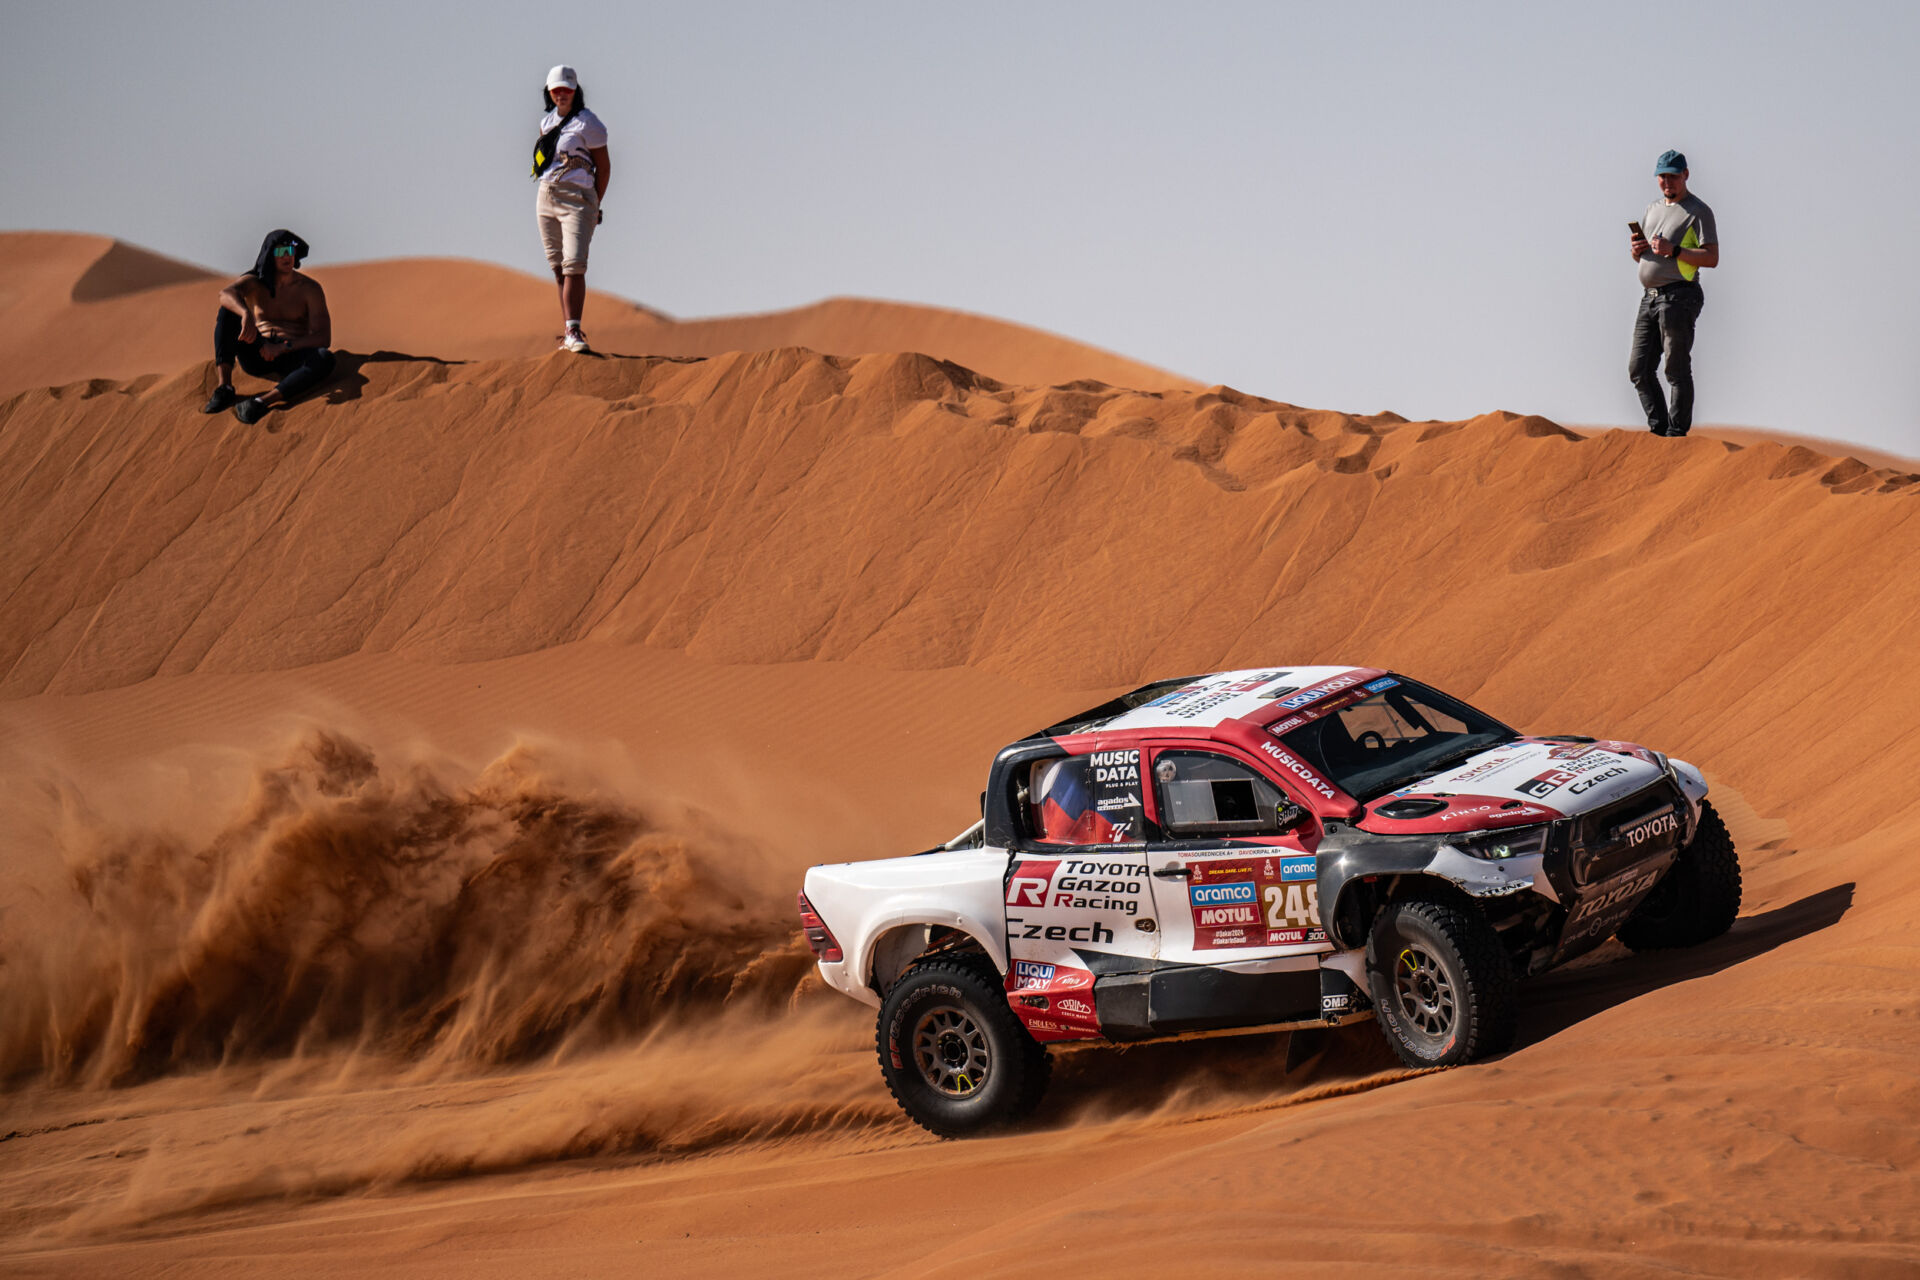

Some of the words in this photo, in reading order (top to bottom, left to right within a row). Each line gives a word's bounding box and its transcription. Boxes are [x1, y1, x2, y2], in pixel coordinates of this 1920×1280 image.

[1281, 689, 1327, 708] LIQUI
[1319, 676, 1357, 692] MOLY
[1367, 680, 1394, 691] aramco
[1272, 717, 1302, 734] MOTUL
[1090, 750, 1140, 767] MUSIC
[1556, 752, 1606, 769] TOYOTA
[1566, 757, 1611, 771] GAZOO
[1575, 759, 1622, 774] Racing
[1096, 766, 1139, 782] DATA
[1260, 741, 1335, 799] MUSICDATA
[1449, 757, 1510, 782] TOYOTA
[1528, 772, 1577, 798] GR
[1568, 767, 1628, 795] Czech
[1097, 796, 1129, 806] agados
[1440, 805, 1491, 821] KINTO
[1626, 813, 1678, 847] TOYOTA
[1067, 861, 1149, 877] TOYOTA
[1283, 863, 1317, 874] aramc
[1057, 877, 1141, 894] GAZOO
[1195, 886, 1251, 902] aramco
[1053, 894, 1138, 915] Racing
[1201, 907, 1254, 925] MOTUL
[1269, 931, 1303, 942] MOTUL
[1307, 931, 1328, 940] 300
[1018, 963, 1053, 979] LIQUI
[1017, 976, 1050, 989] MOLY
[1062, 999, 1086, 1013] PRIM
[1322, 997, 1348, 1008] OMP
[1028, 1019, 1057, 1029] ENDLESS
